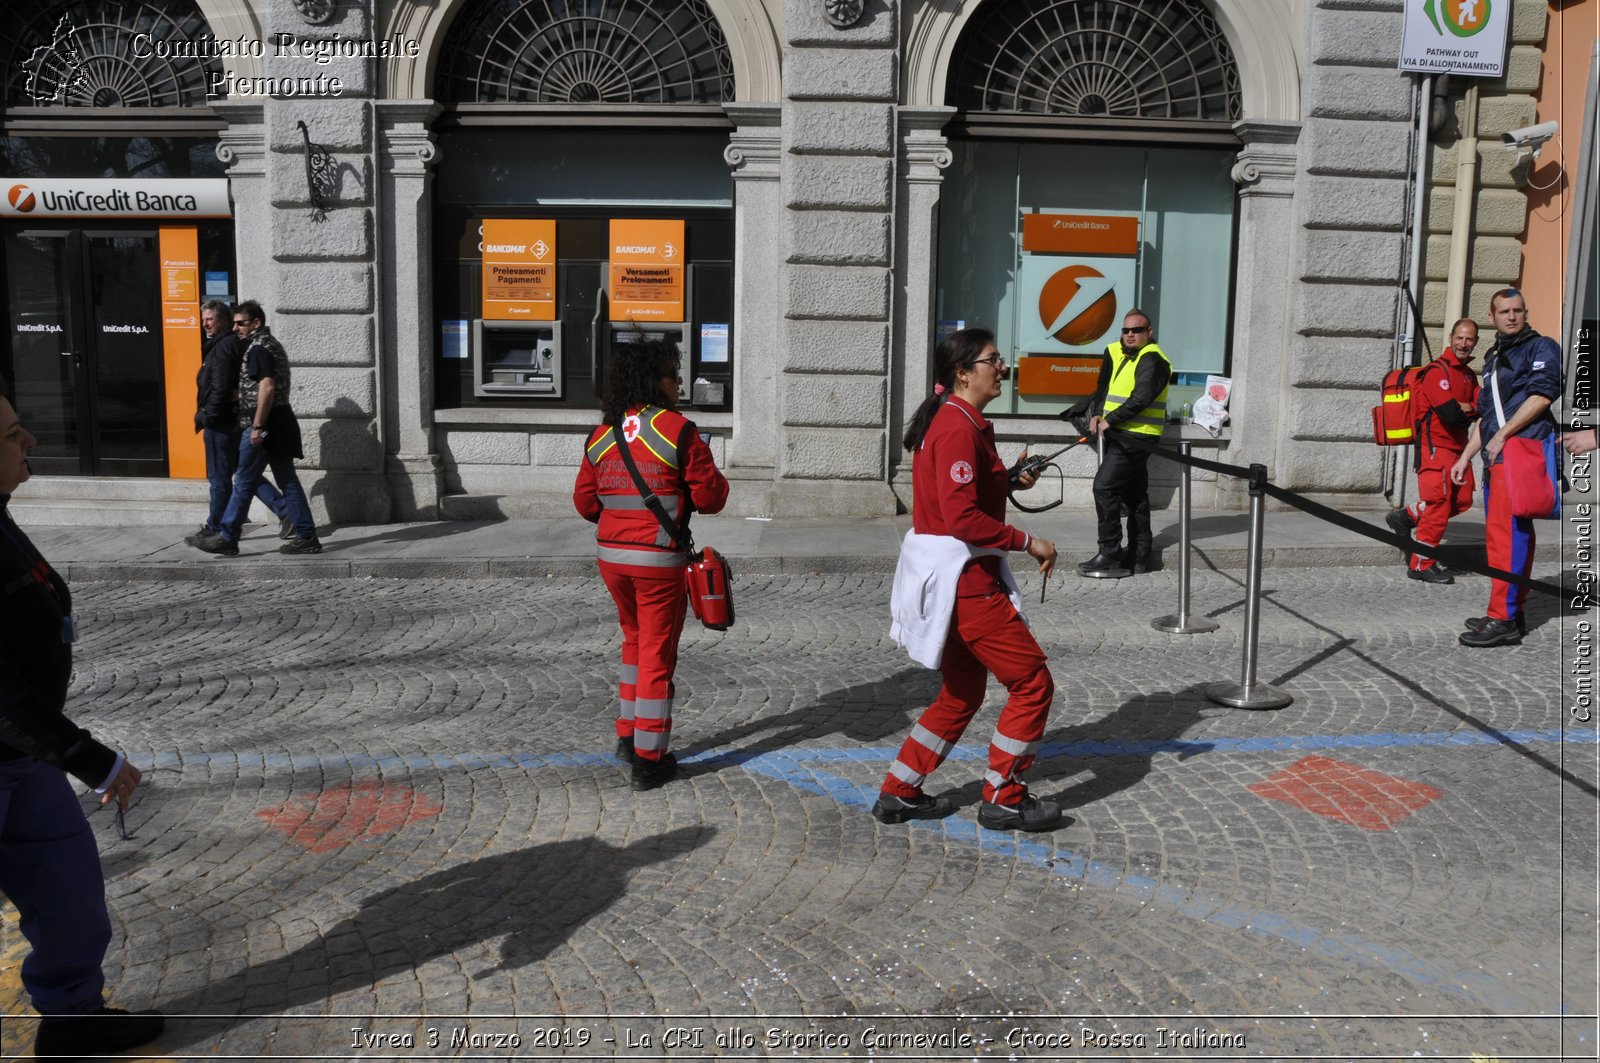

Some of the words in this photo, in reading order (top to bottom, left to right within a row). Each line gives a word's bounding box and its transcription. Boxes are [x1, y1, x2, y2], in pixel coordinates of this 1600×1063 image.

[1426, 48, 1461, 58] PATHWAY
[1463, 50, 1479, 59] OUT
[1403, 57, 1417, 66] VIA
[1419, 59, 1428, 67] DI
[1429, 59, 1499, 71] ALLONTANAMENTO
[42, 188, 132, 212] UniCredit
[135, 191, 197, 212] Banca
[1062, 221, 1090, 229] UniCredit
[1090, 222, 1110, 230] Banca
[486, 245, 526, 253] BANCOMAT
[615, 246, 656, 254] BANCOMAT
[492, 267, 546, 275] Prelevamenti
[625, 268, 669, 276] Versamenti
[497, 276, 541, 284] Pagamenti
[621, 276, 673, 284] Prelevamenti
[17, 324, 45, 332] UniCredit
[45, 324, 64, 333] S.p.A.
[103, 325, 131, 333] UniCredit
[131, 325, 150, 334] S.p.A.
[1050, 364, 1071, 373] Posso
[634, 461, 662, 475] TALIANA
